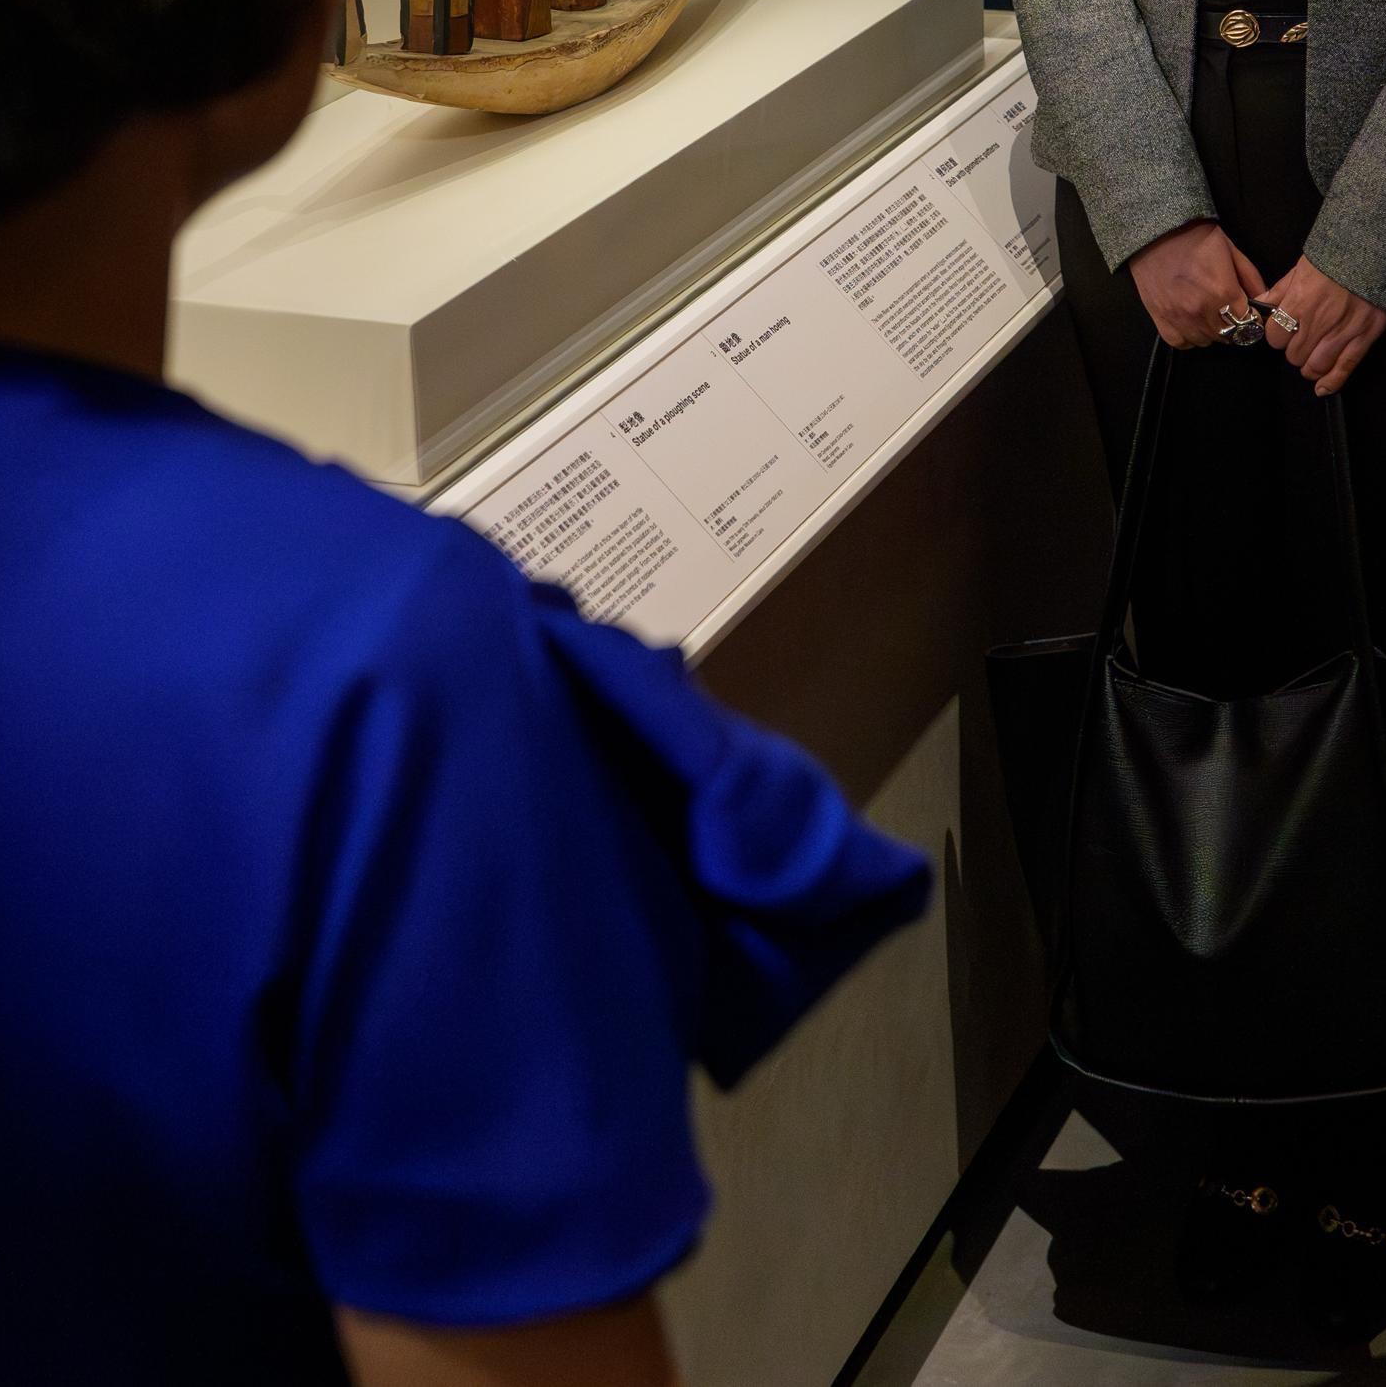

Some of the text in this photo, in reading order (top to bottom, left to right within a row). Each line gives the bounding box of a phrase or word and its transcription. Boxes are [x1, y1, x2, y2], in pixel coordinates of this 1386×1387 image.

[945, 177, 958, 187] Dish
[964, 155, 985, 174] geometric
[982, 142, 1000, 159] patterns
[731, 348, 751, 364] Statue
[749, 341, 757, 350] of
[759, 331, 772, 342] man
[768, 316, 791, 334] hoeing
[618, 411, 645, 434] 犁地像
[632, 428, 654, 446] Statue
[652, 419, 661, 430] of
[664, 395, 695, 424] ploughing
[692, 382, 710, 398] scene
